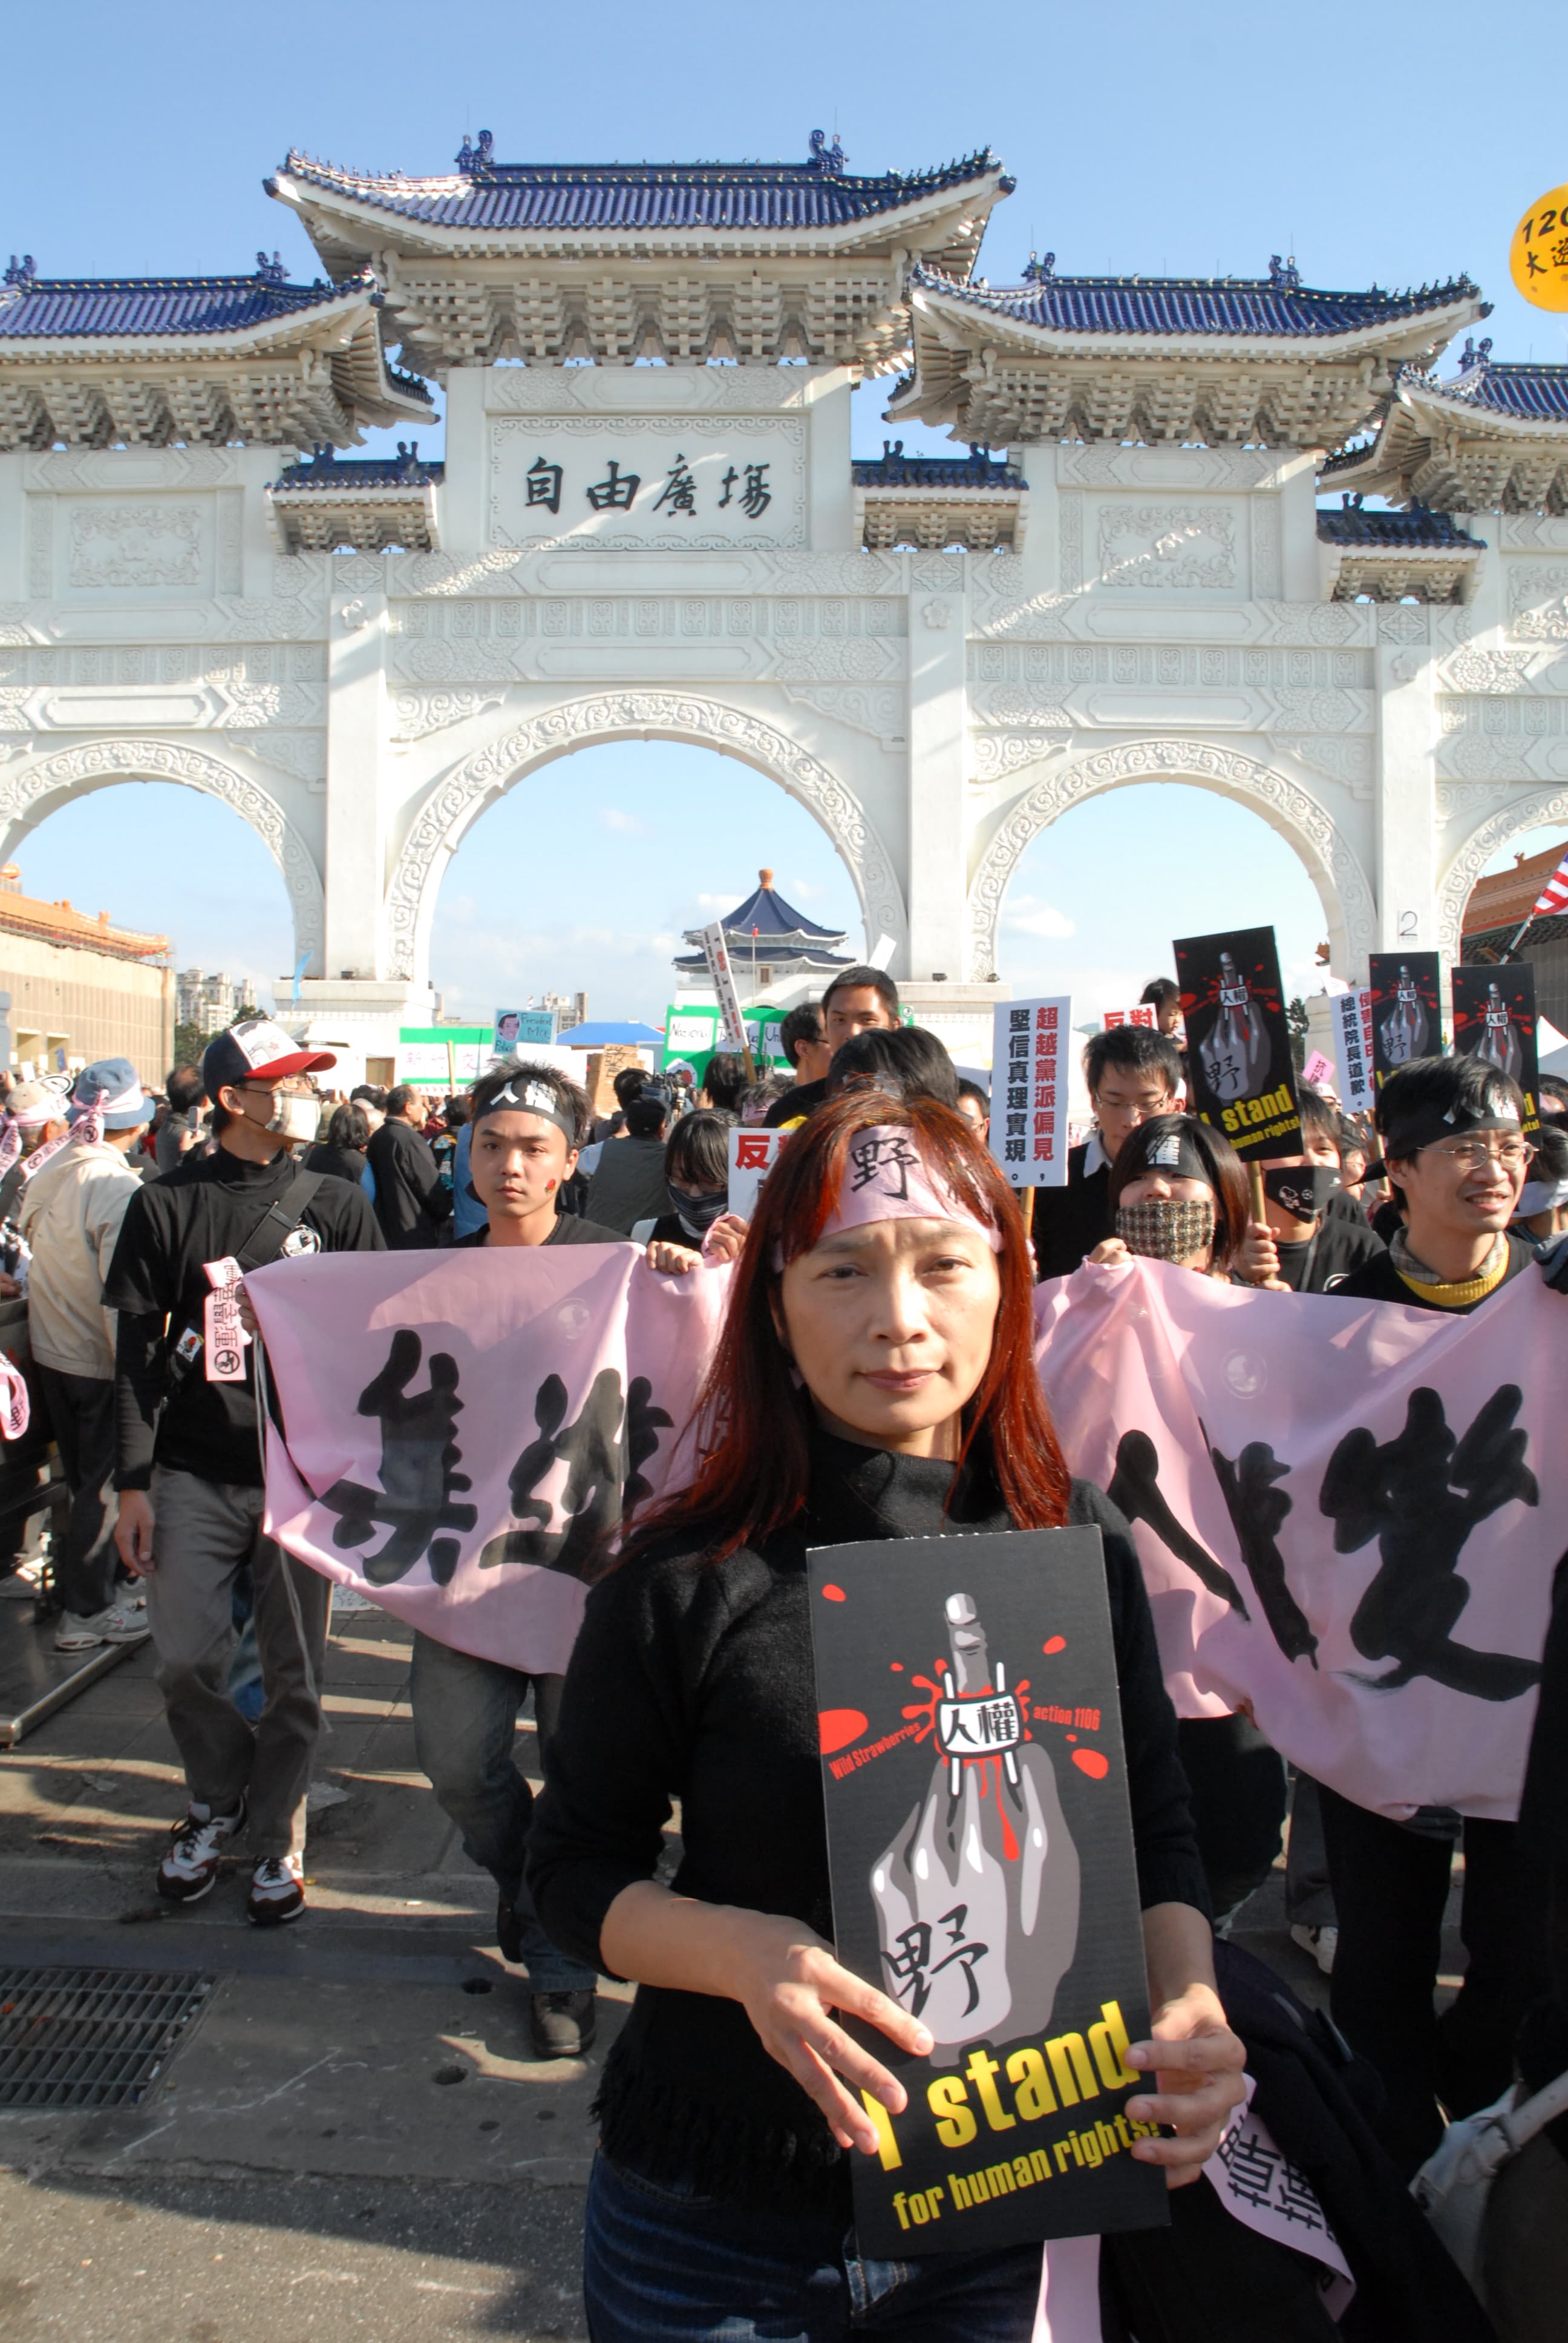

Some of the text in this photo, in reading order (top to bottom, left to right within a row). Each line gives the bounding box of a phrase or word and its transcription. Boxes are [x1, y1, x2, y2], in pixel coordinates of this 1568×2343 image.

[525, 453, 773, 519] 自由廣場
[1399, 911, 1418, 936] 2
[1221, 988, 1248, 1003] 人權
[1383, 1034, 1407, 1058] 野
[1005, 1009, 1031, 1181] 堅信真理實現。
[1205, 1055, 1240, 1089] 野
[1221, 1084, 1295, 1132] stand
[1264, 1115, 1300, 1137] rights!
[851, 1138, 921, 1201] 野
[950, 1701, 1017, 1745] 人權
[1033, 1705, 1101, 1731] action 1106
[828, 1722, 922, 1780] Wild Strawberries
[880, 1904, 989, 2019] 野
[927, 2000, 1141, 2148] stand
[892, 2184, 944, 2230] for
[947, 2148, 1053, 2211] human
